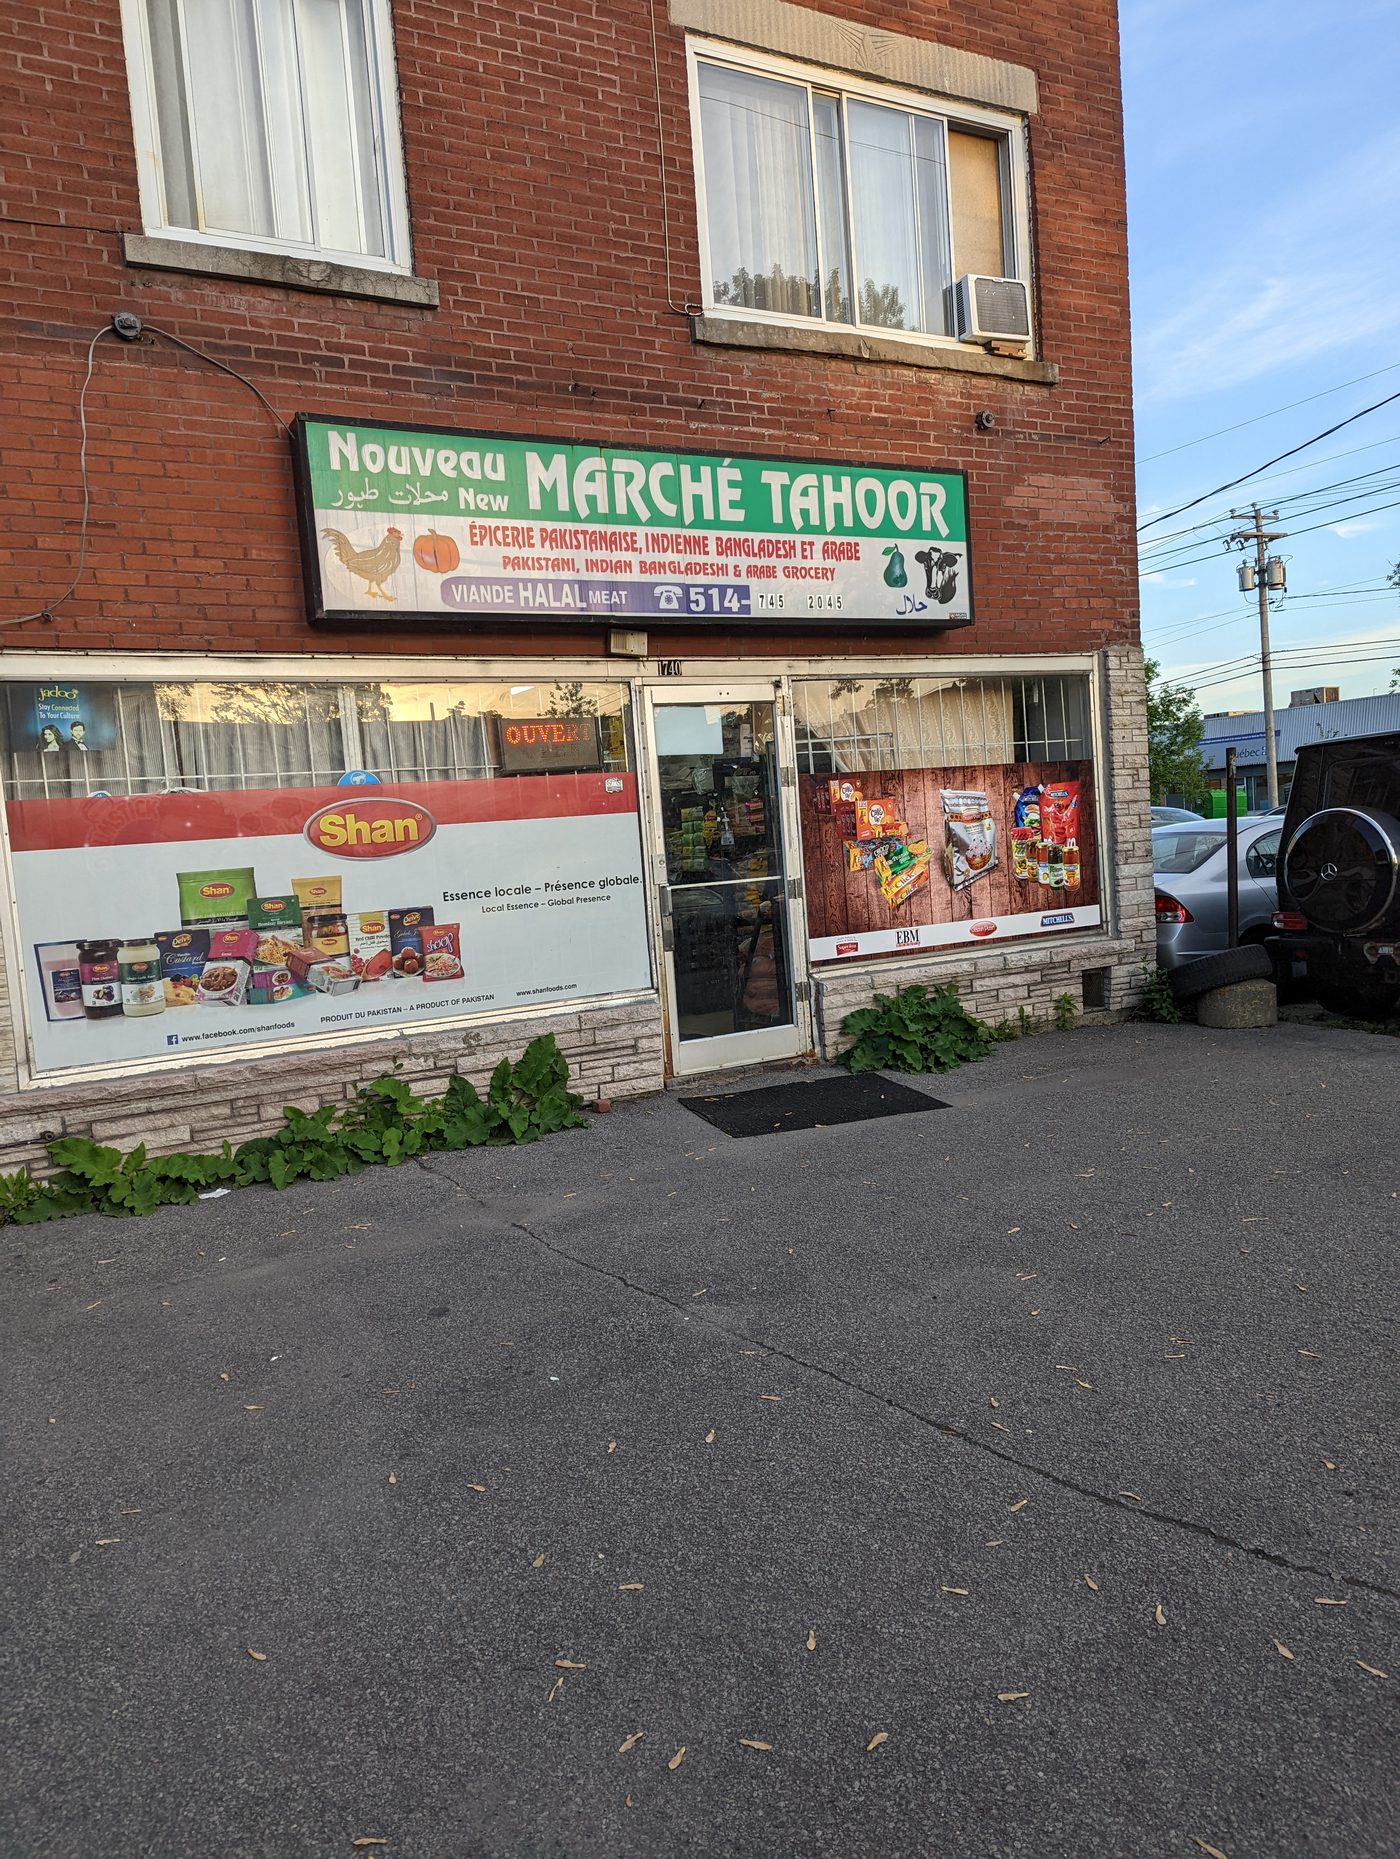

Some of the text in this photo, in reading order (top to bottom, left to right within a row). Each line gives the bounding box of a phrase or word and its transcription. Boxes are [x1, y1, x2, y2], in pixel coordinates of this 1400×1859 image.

[328, 431, 950, 538] Nouveau MARCHÉ TAHOOR
[458, 487, 509, 512] New
[469, 521, 860, 562] ÉPICERIE PAKISTANAISE, INDIENNE BANGLADESH ET ARABE
[502, 555, 836, 581] PAKISTANI, INDIAN BANGLADESHI & ARABE GROCERY
[451, 584, 514, 604] VIANDE
[518, 582, 587, 608] HALAL
[589, 590, 627, 605] MEAT
[758, 594, 784, 609] 745
[808, 595, 843, 609] 2045
[896, 593, 928, 616] حلال
[657, 660, 682, 676] 1740
[38, 685, 79, 701] jadoo
[38, 703, 51, 711] Stay
[39, 711, 46, 719] To
[506, 722, 591, 745] OUVERT
[202, 886, 230, 895] Shan
[443, 888, 491, 902] Essence
[494, 884, 532, 897] locale
[544, 880, 595, 892] Présence
[598, 874, 643, 890] globale.
[263, 902, 284, 910] Shan
[482, 904, 505, 914] Local
[507, 901, 539, 911] Essence
[548, 897, 574, 907] Global
[576, 893, 611, 904] Presence
[361, 924, 382, 932] Shan
[896, 929, 919, 944] EBM
[516, 982, 578, 997] www.shanfoods.com
[320, 1013, 353, 1023] PRODUIT
[355, 1011, 366, 1019] DU
[367, 1006, 402, 1018] PAKISTAN
[416, 1001, 449, 1011] PRODUCT
[462, 994, 495, 1004] PAKISTAN
[182, 1021, 295, 1042] www.facebook.com/shanfoods
